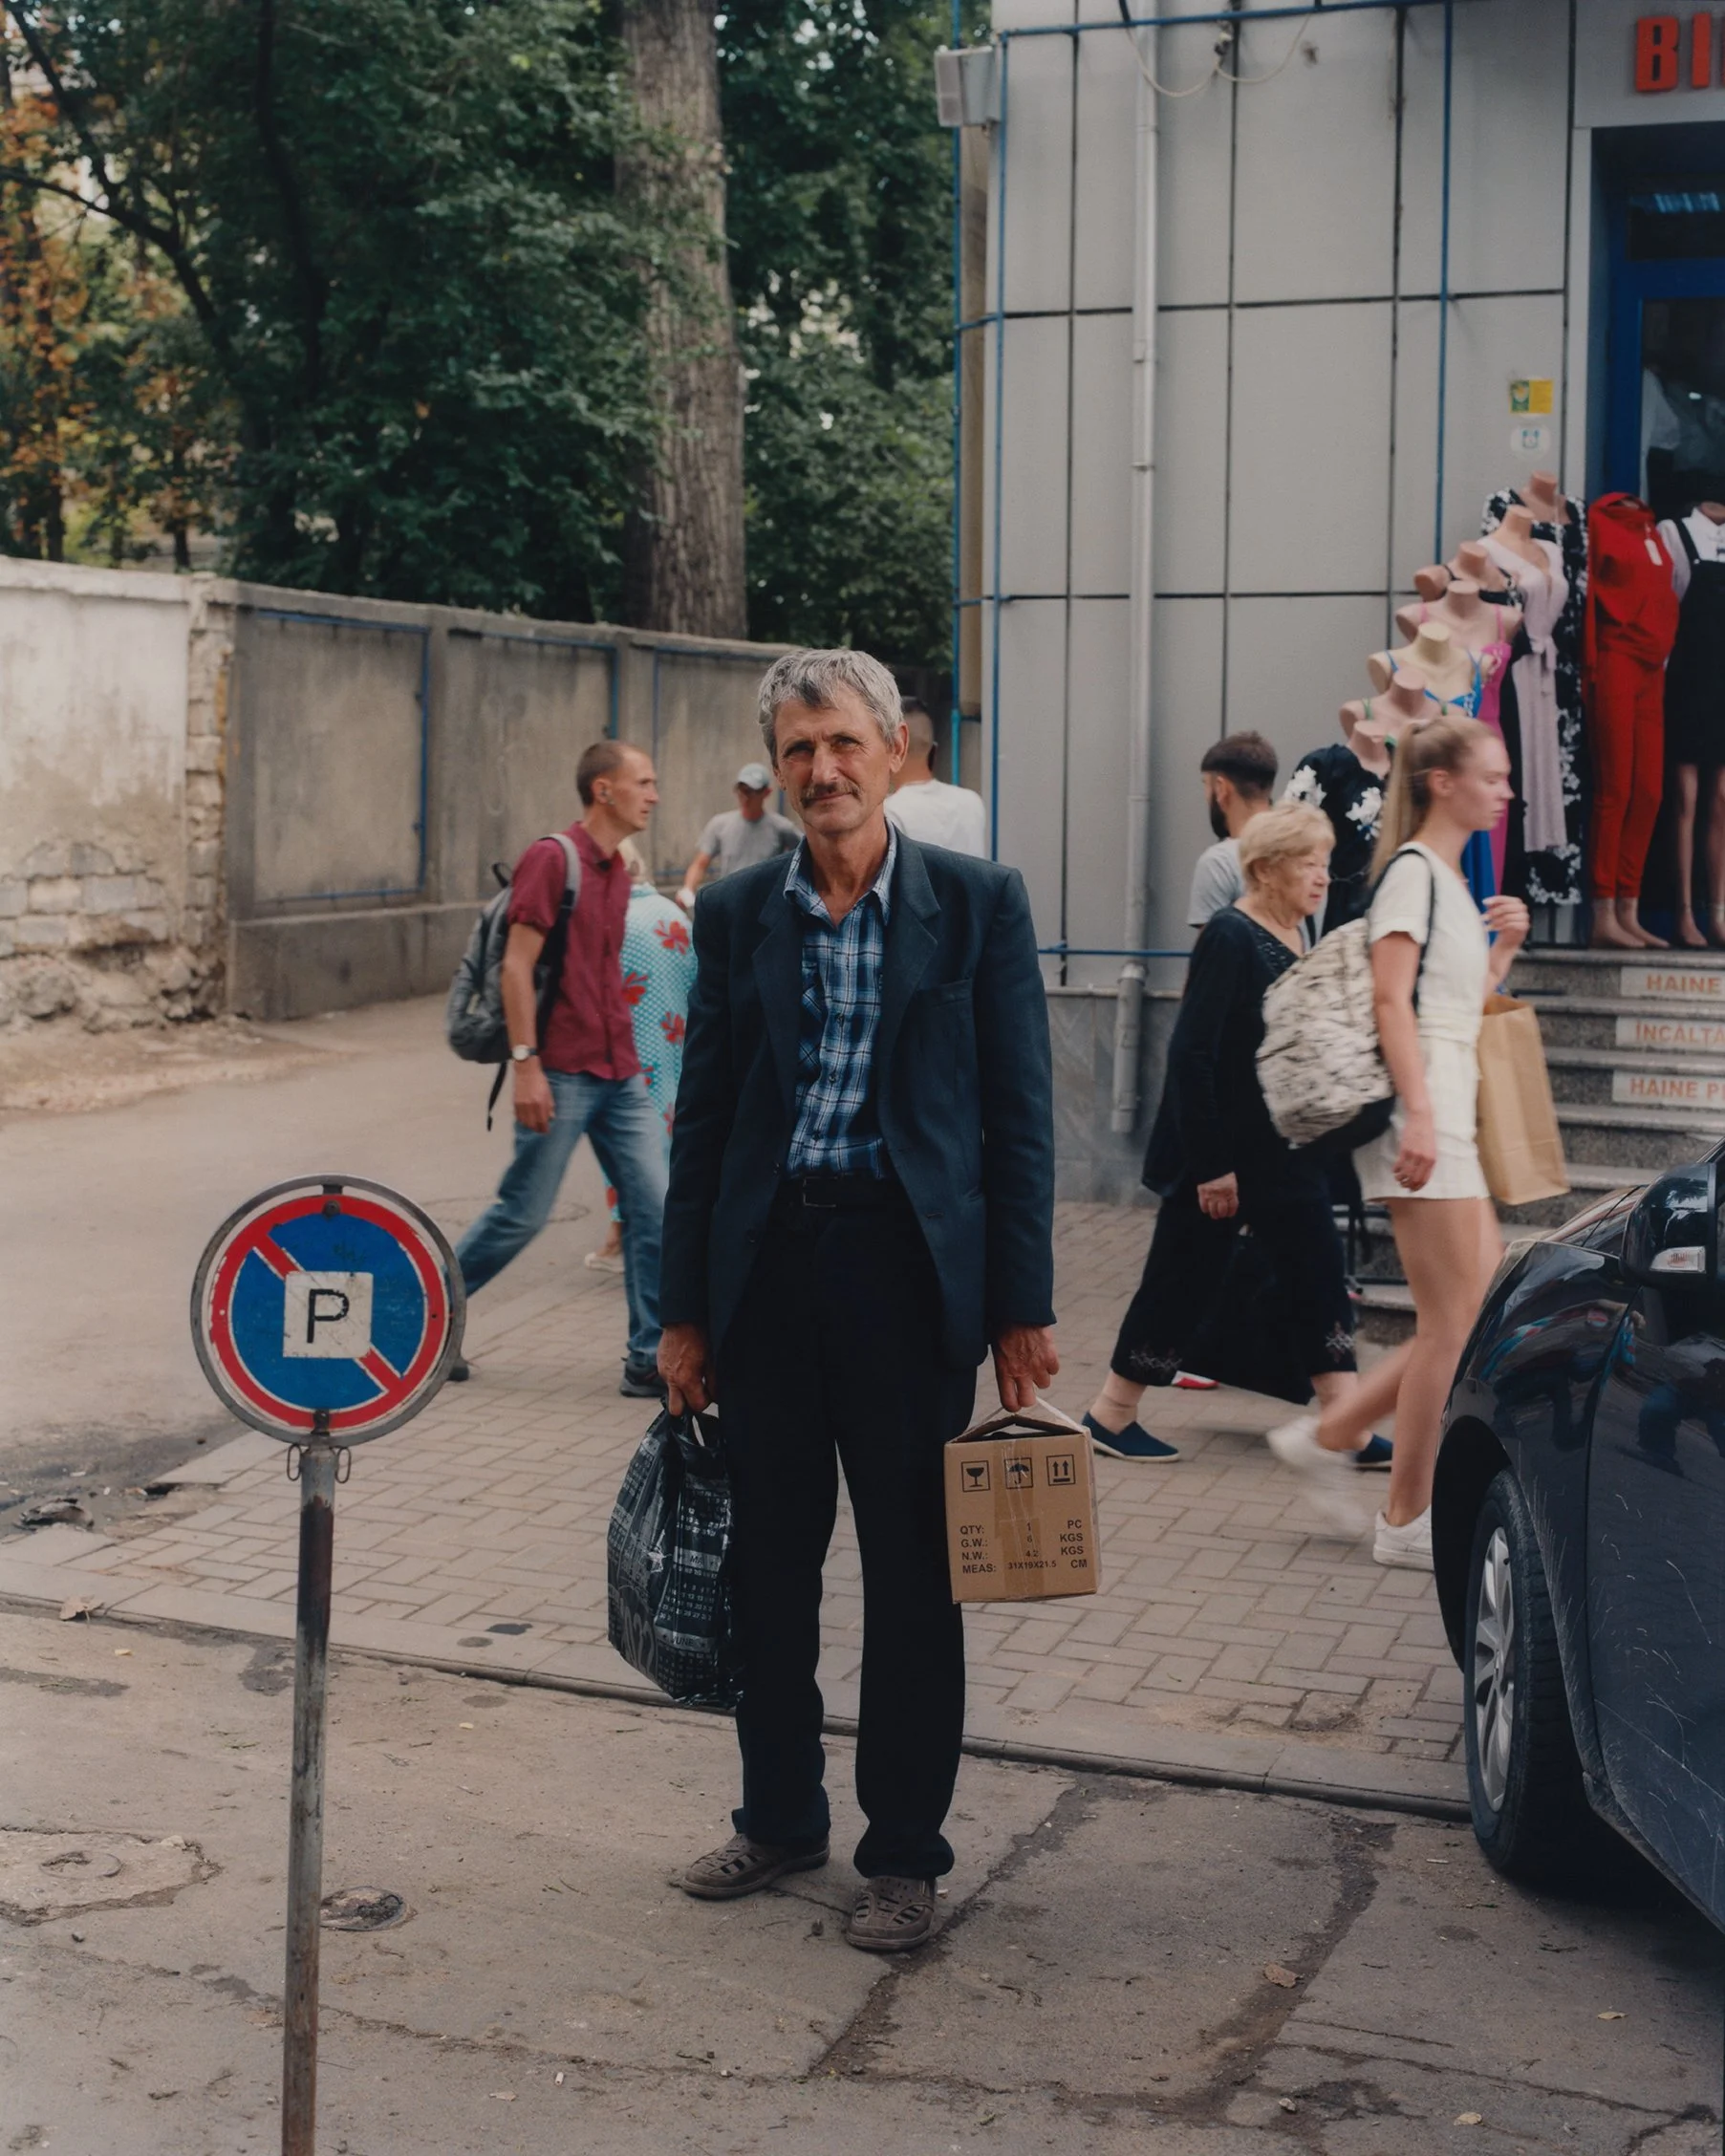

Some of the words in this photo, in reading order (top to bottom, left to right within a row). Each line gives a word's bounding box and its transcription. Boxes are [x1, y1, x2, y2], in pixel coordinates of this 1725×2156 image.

[1636, 12, 1725, 93] BI
[1646, 973, 1721, 994] HAINE
[1629, 1077, 1698, 1098] HAINE
[306, 1288, 350, 1344] P
[960, 1524, 984, 1535] QTY:
[1067, 1520, 1082, 1529] PC
[1060, 1533, 1084, 1542] KGS
[1061, 1546, 1084, 1556] KGS
[962, 1563, 997, 1574] MEAS:
[1070, 1559, 1088, 1568] CM
